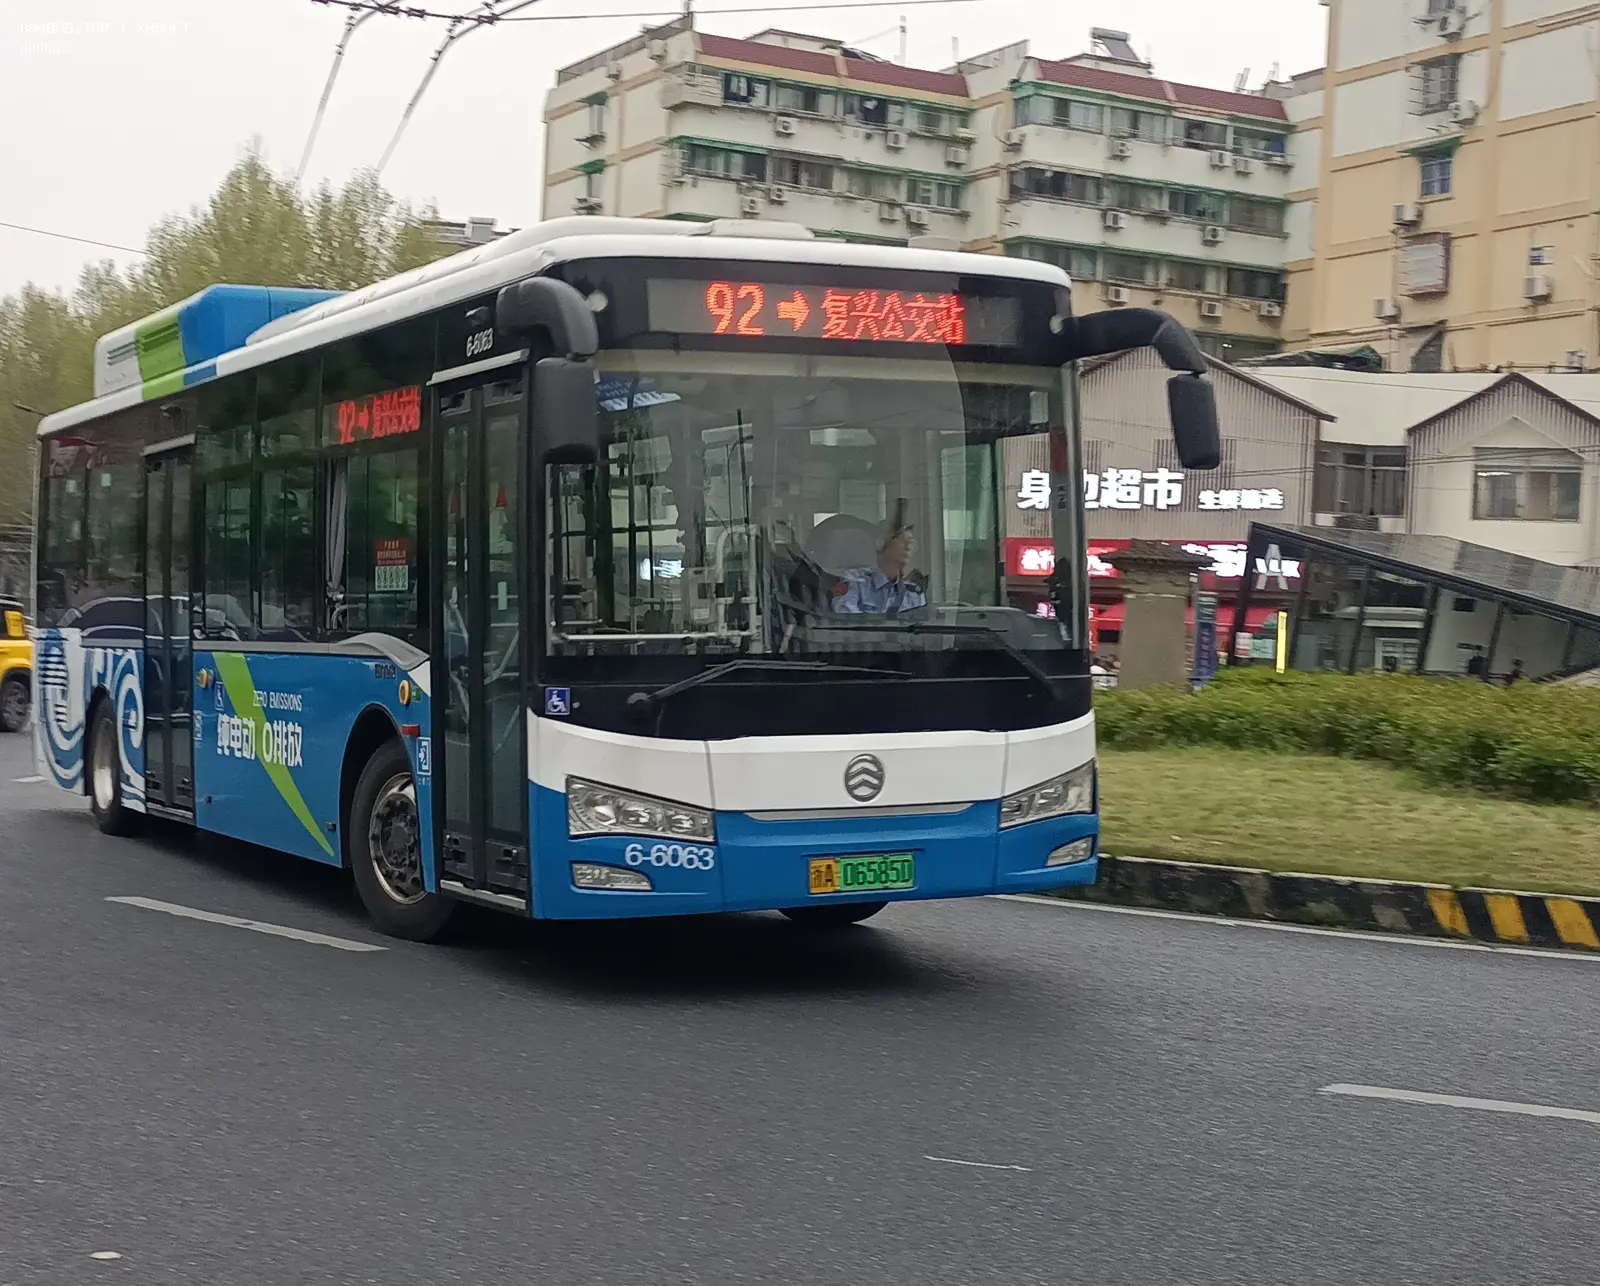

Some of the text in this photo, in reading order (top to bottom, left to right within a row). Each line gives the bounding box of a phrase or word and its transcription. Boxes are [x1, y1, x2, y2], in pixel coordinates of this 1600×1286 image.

[705, 280, 965, 345] 92 复兴公交站
[269, 691, 303, 712] EMISSIONS
[216, 713, 256, 760] 纯电动
[624, 843, 715, 871] 6-6063
